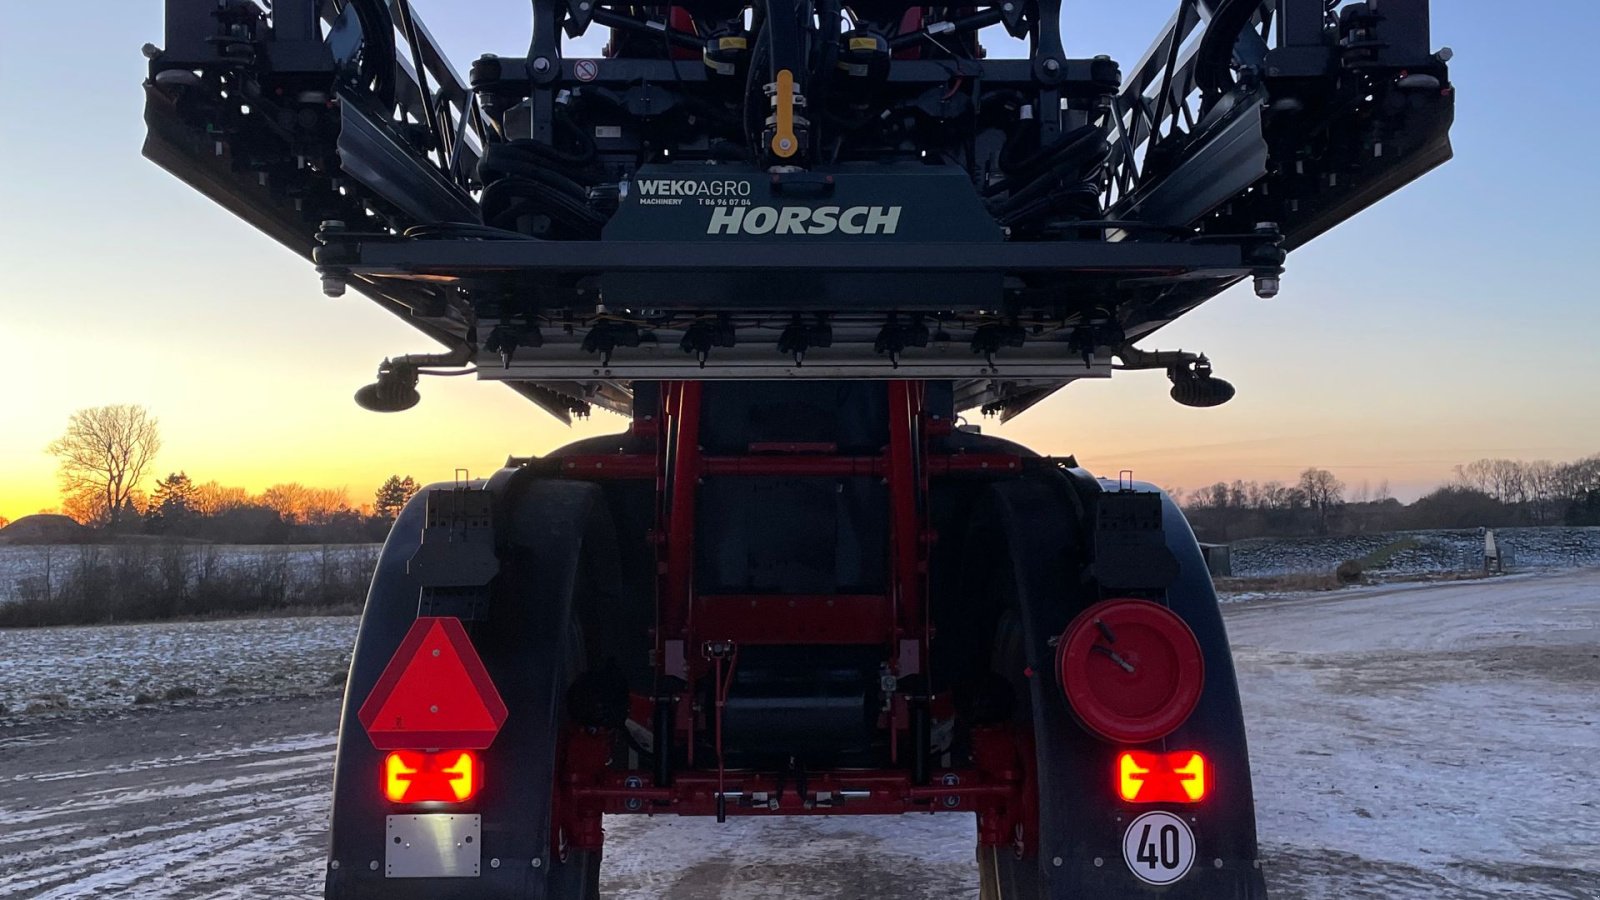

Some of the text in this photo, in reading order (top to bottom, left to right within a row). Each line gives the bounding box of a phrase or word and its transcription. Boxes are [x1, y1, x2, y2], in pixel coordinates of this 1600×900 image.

[638, 180, 751, 196] WEKOAGRO
[706, 206, 902, 235] HORSCH
[1136, 824, 1180, 870] 40
